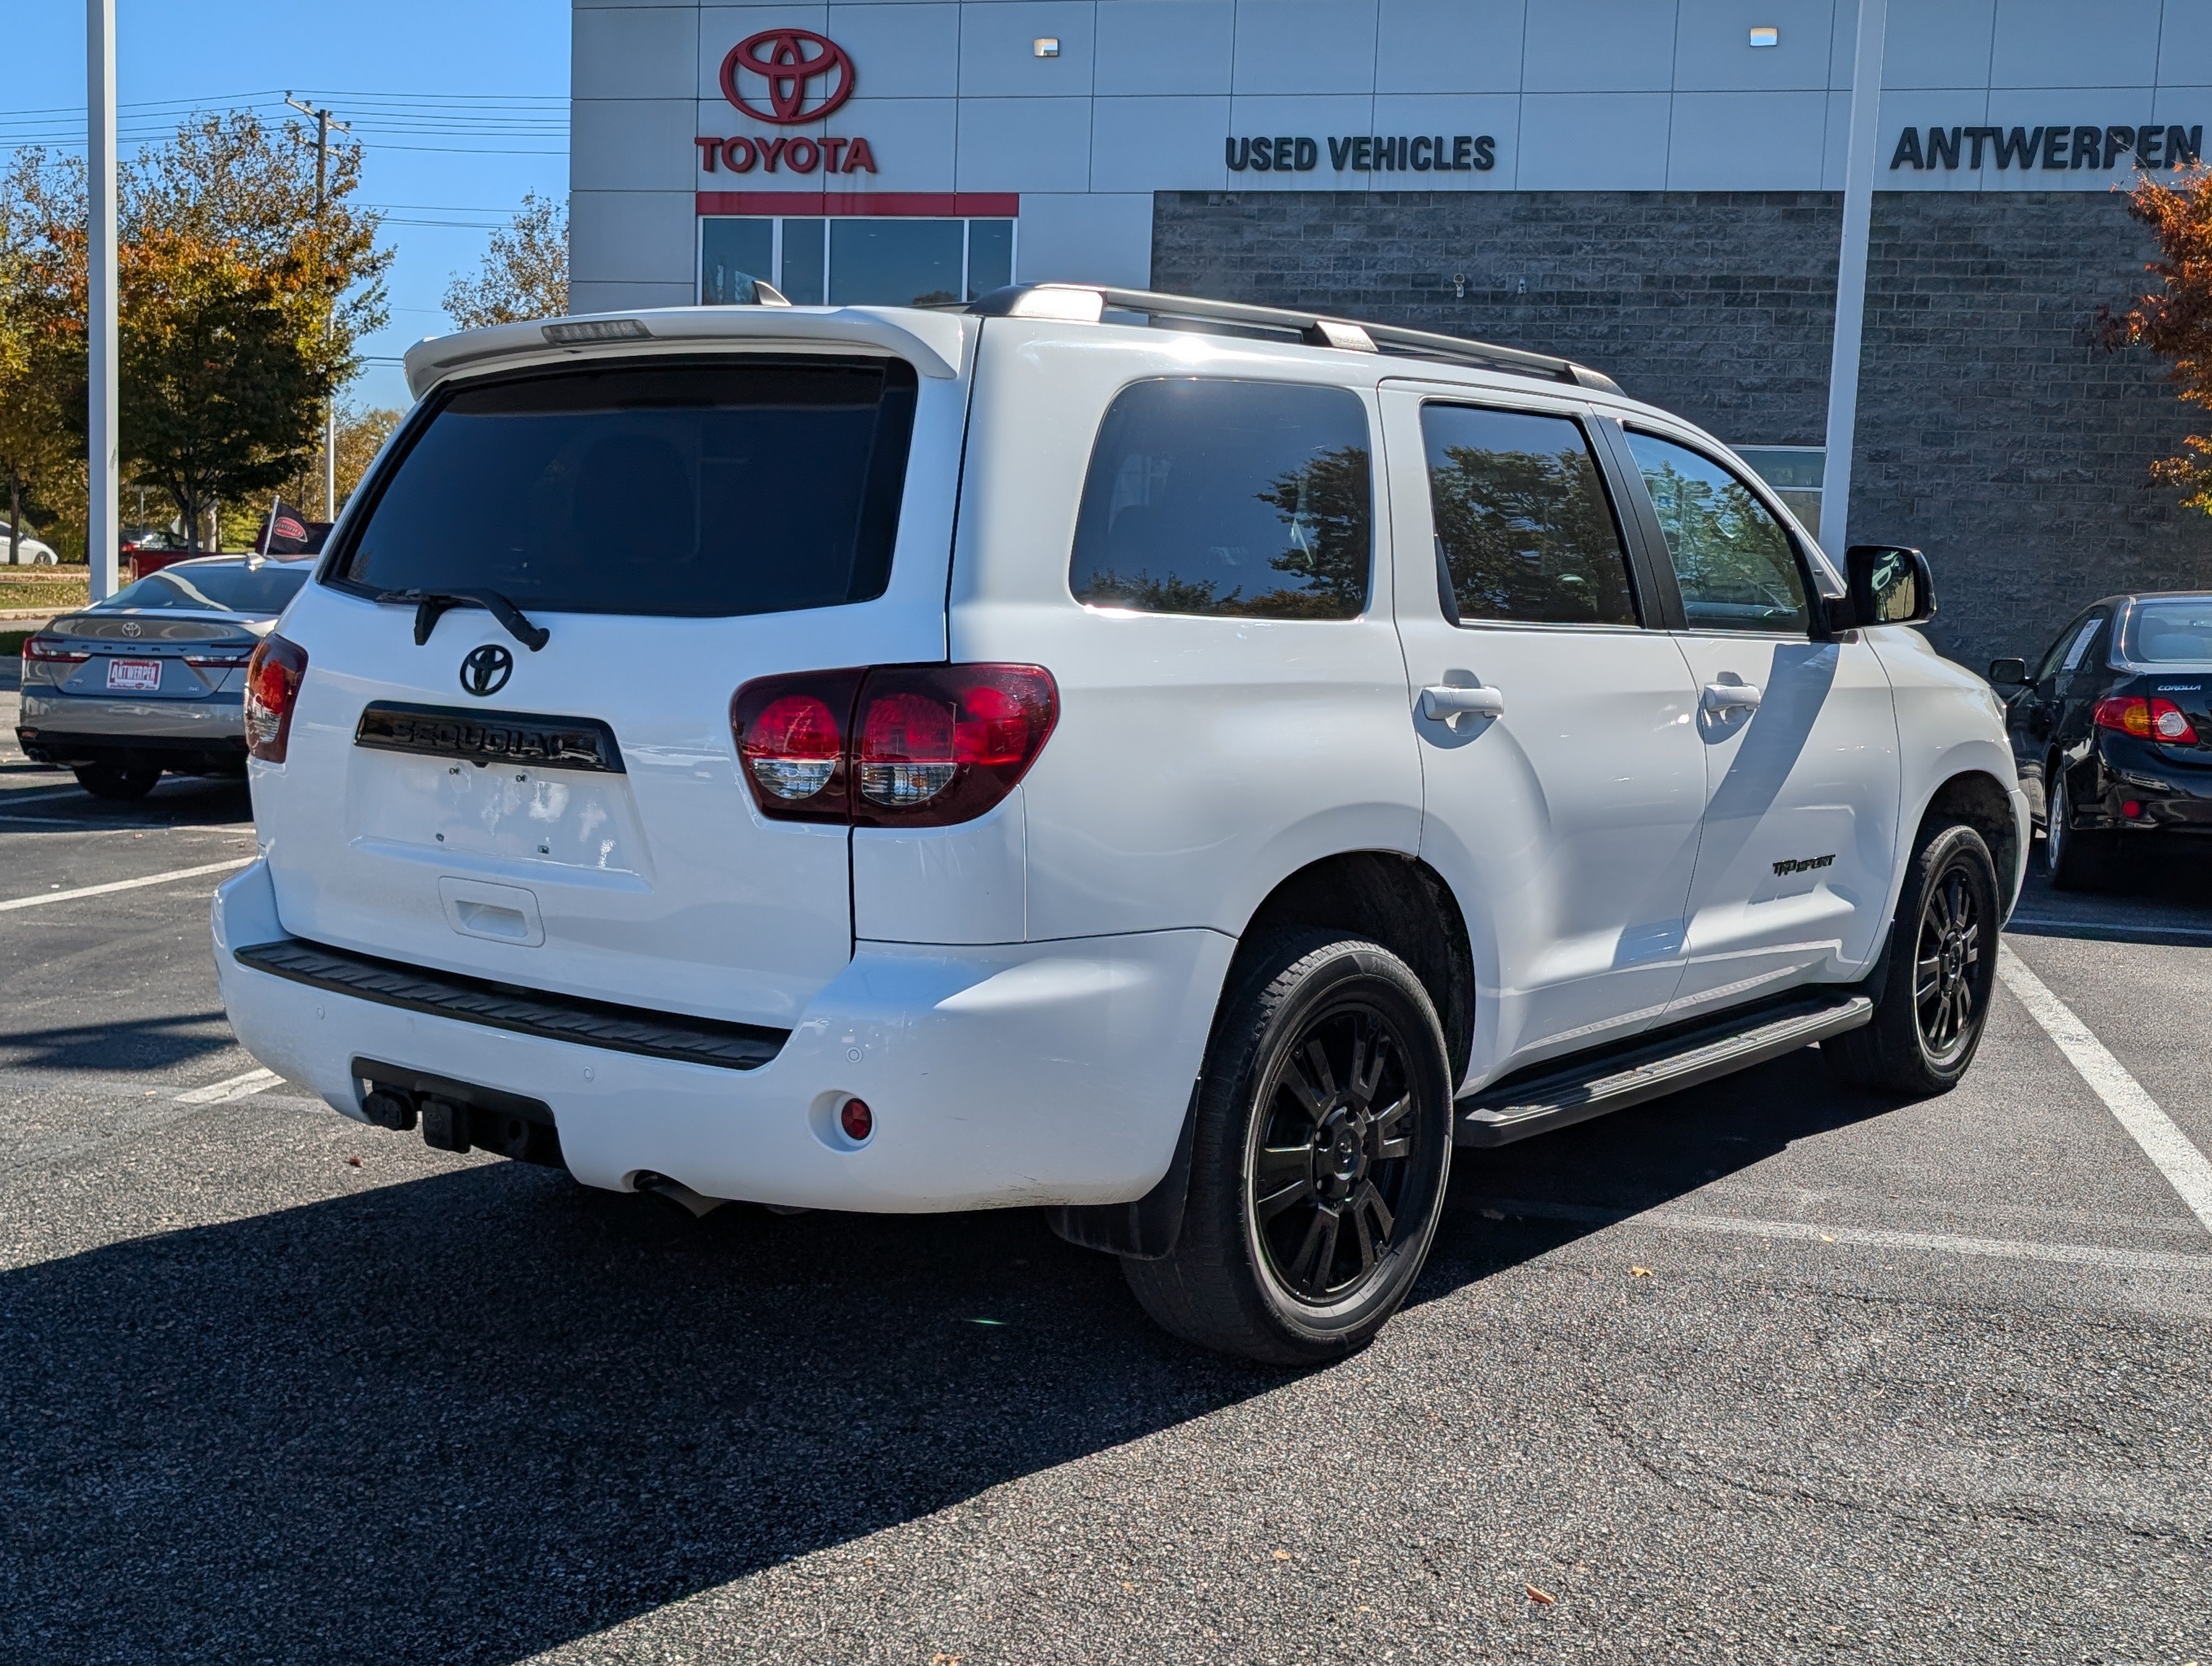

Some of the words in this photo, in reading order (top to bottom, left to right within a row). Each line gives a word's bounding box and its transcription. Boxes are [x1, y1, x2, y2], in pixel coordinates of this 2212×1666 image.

[694, 136, 877, 174] TOYOTA
[1225, 137, 1317, 171] USED
[1327, 135, 1495, 171] VEHICLES
[1889, 125, 2203, 170] ANTWERPEN
[111, 664, 156, 680] ANTWERPEN
[391, 720, 551, 757] SEQUOIA
